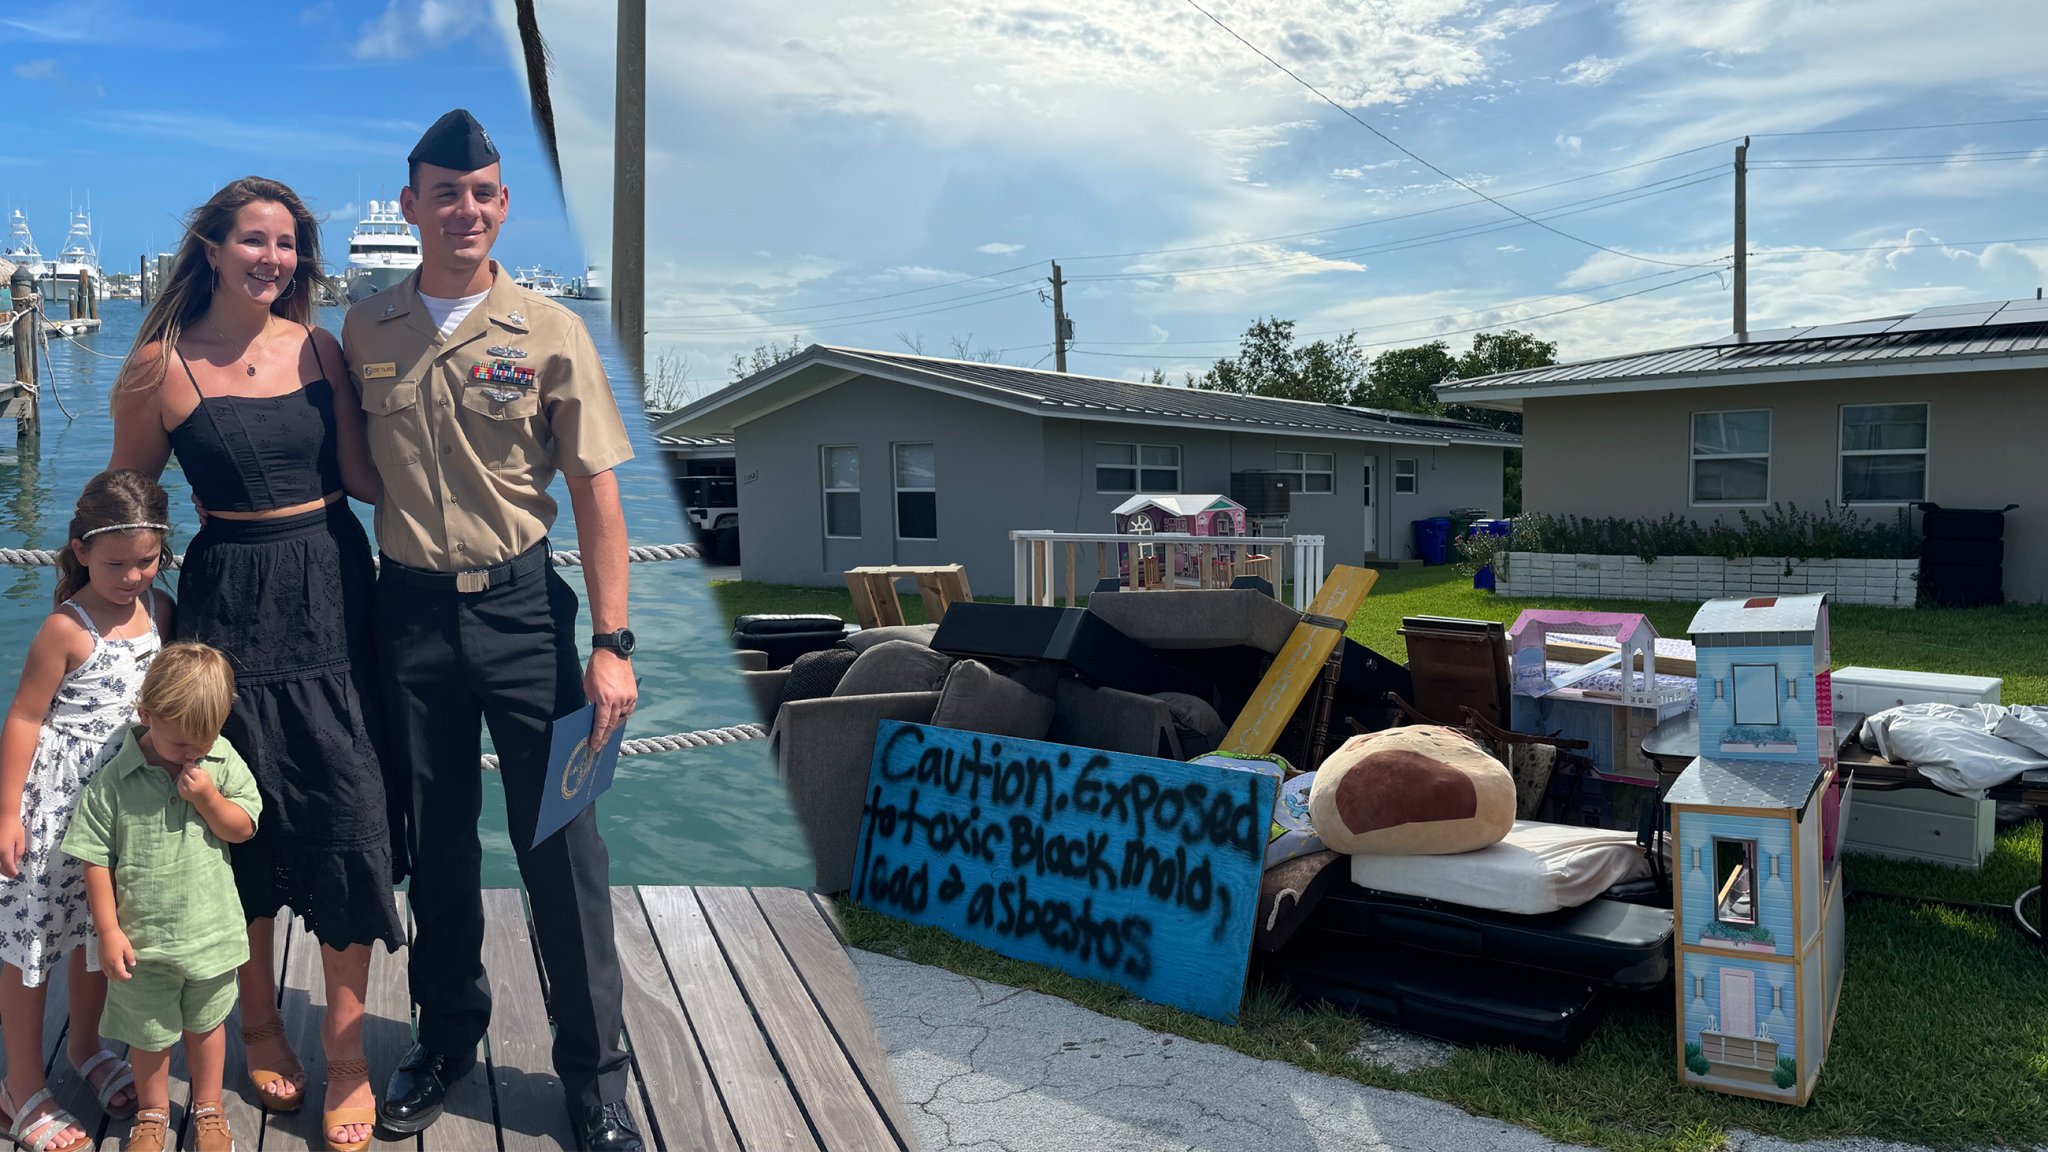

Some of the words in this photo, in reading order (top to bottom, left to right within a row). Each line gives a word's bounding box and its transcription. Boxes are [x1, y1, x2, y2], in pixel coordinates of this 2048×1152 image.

[863, 784, 898, 838] to
[898, 787, 1005, 863] toxic
[1009, 814, 1118, 891] Black
[880, 724, 1071, 821] Caution:
[1073, 754, 1260, 862] Exposed
[856, 837, 929, 914] lead
[966, 873, 1153, 982] asbestos
